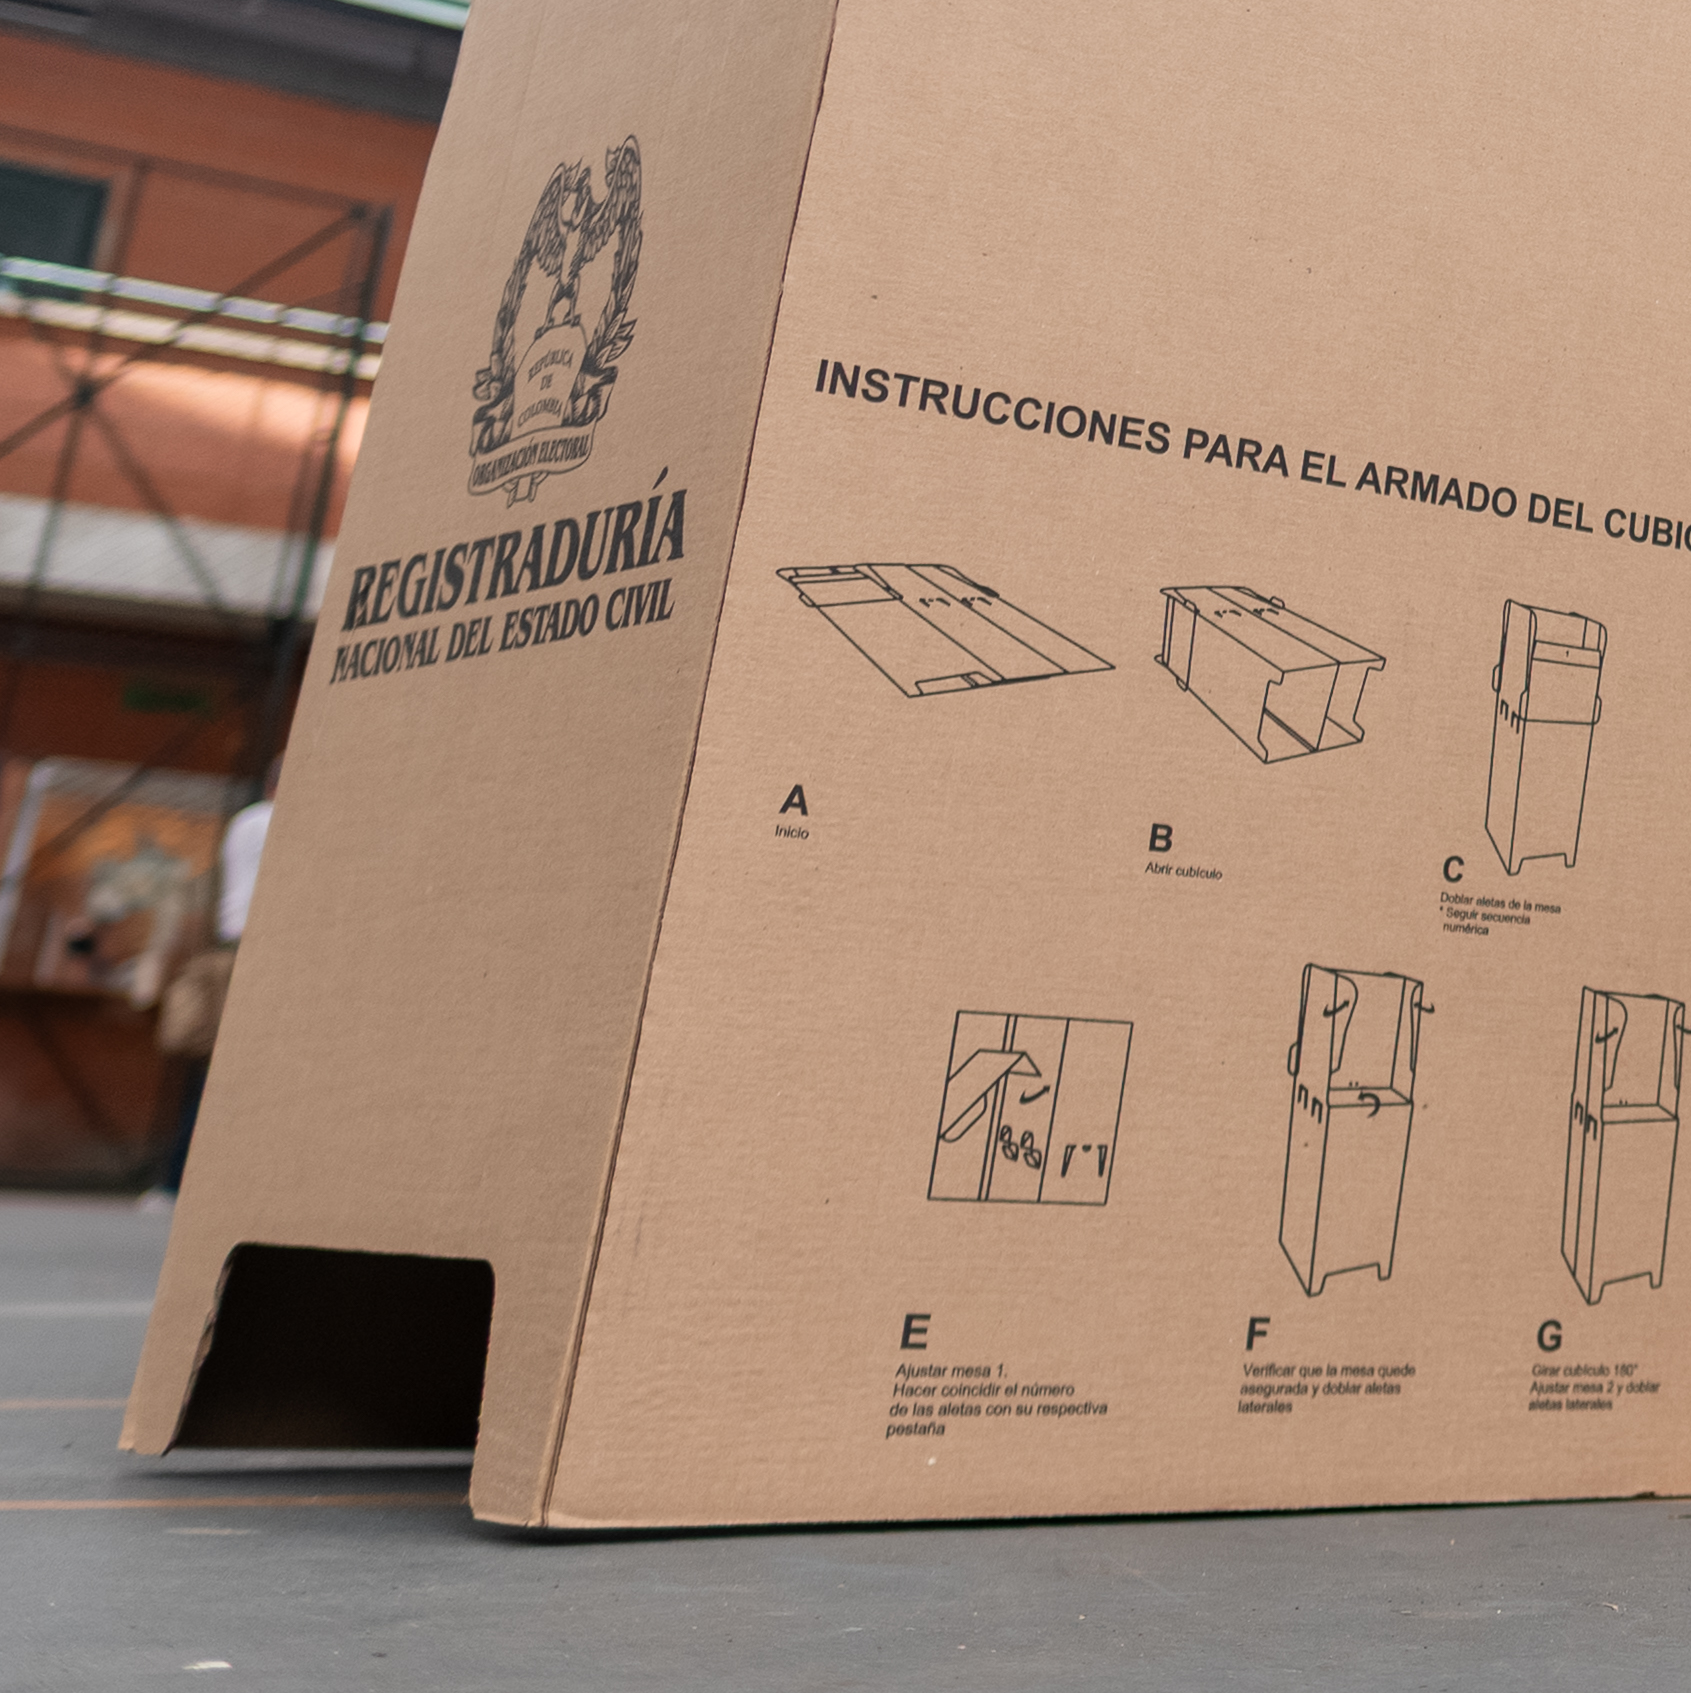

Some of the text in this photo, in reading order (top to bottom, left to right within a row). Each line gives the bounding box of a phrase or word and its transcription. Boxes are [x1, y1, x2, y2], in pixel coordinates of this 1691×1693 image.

[528, 348, 574, 383] REPÚBLICA
[540, 373, 554, 391] DE
[517, 396, 563, 428] COLOMBIA
[814, 358, 1171, 456] INSTRUCCIONES
[1181, 428, 1290, 477] PARA
[1300, 450, 1347, 488] EL
[1355, 459, 1517, 519] ARMADO
[1526, 492, 1594, 534] DEL
[472, 434, 590, 487] ORGANIZACIÓN ELECTORAL
[340, 466, 688, 632] REGISTRADURÍA
[329, 577, 676, 685] NACIONAL DEL ESTADO CIVIL
[779, 784, 808, 816] A
[775, 824, 809, 840] Inicio
[1149, 823, 1173, 853] B
[1145, 861, 1173, 875] Abrir
[1442, 855, 1464, 883] C
[1440, 892, 1562, 914] Doblar aletas de la mesa
[1446, 907, 1530, 925] Seguir secuencia
[900, 1314, 931, 1350] E
[1246, 1317, 1270, 1351] F
[1537, 1318, 1562, 1353] G
[895, 1363, 1008, 1381] Ajustar mesa 1.
[1243, 1362, 1416, 1379] Verificar que la mesa quede
[1532, 1363, 1561, 1377] Girar
[893, 1382, 1075, 1398] Hacer coincidir el número
[1240, 1381, 1401, 1399] asegurada y doblar aletas
[1529, 1380, 1661, 1397] Ajustar mesa 2 y doblar
[889, 1401, 1108, 1419] de las aletas con su respectiva
[1237, 1399, 1293, 1414] laterales
[1565, 1397, 1613, 1411] laterales
